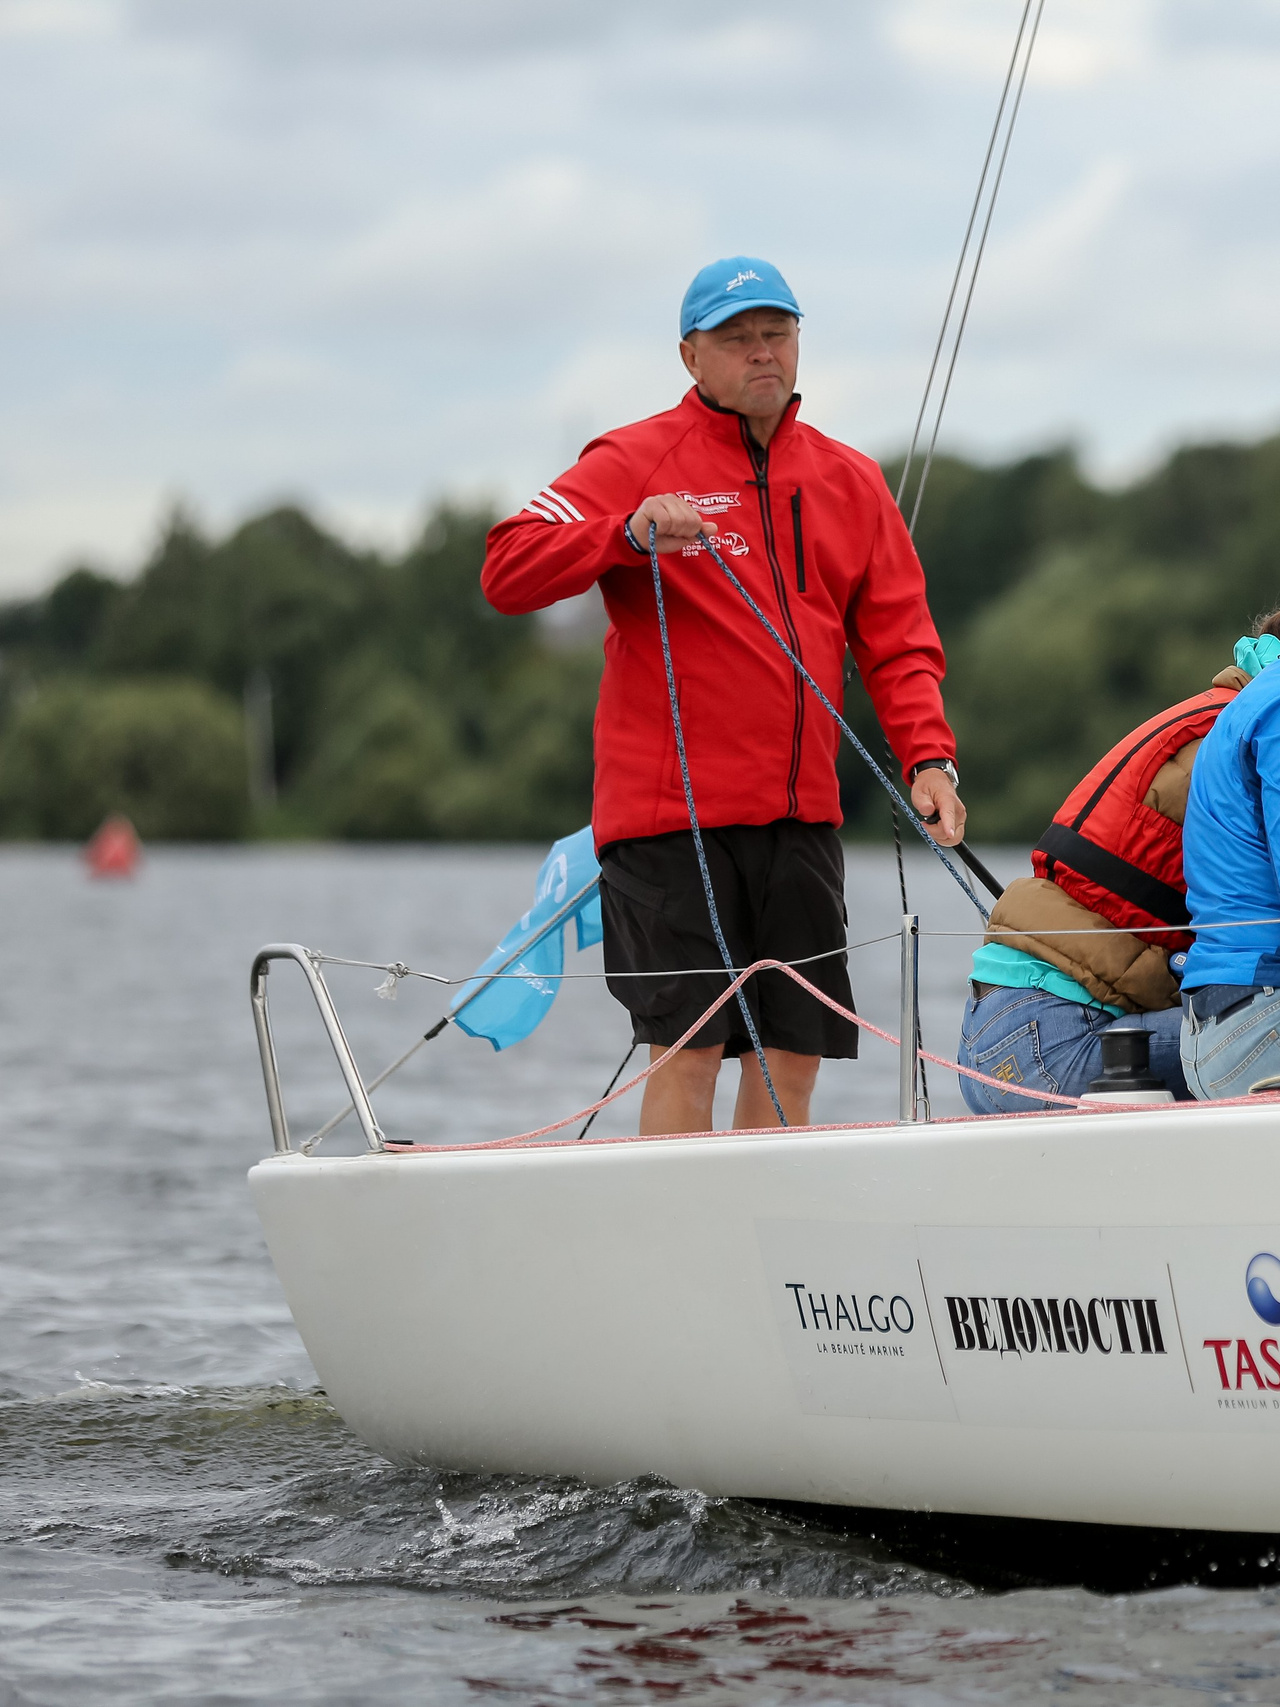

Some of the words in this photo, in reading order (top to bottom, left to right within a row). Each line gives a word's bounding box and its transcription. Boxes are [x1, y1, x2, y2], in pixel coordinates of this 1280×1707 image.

[785, 1283, 914, 1335] THALGO
[944, 1296, 1168, 1361] ВЕДОМОСТИ
[816, 1343, 829, 1354] LA
[831, 1343, 866, 1355] BEAUTÉ
[868, 1345, 905, 1357] MARINE
[1217, 1399, 1268, 1410] PREMIUM
